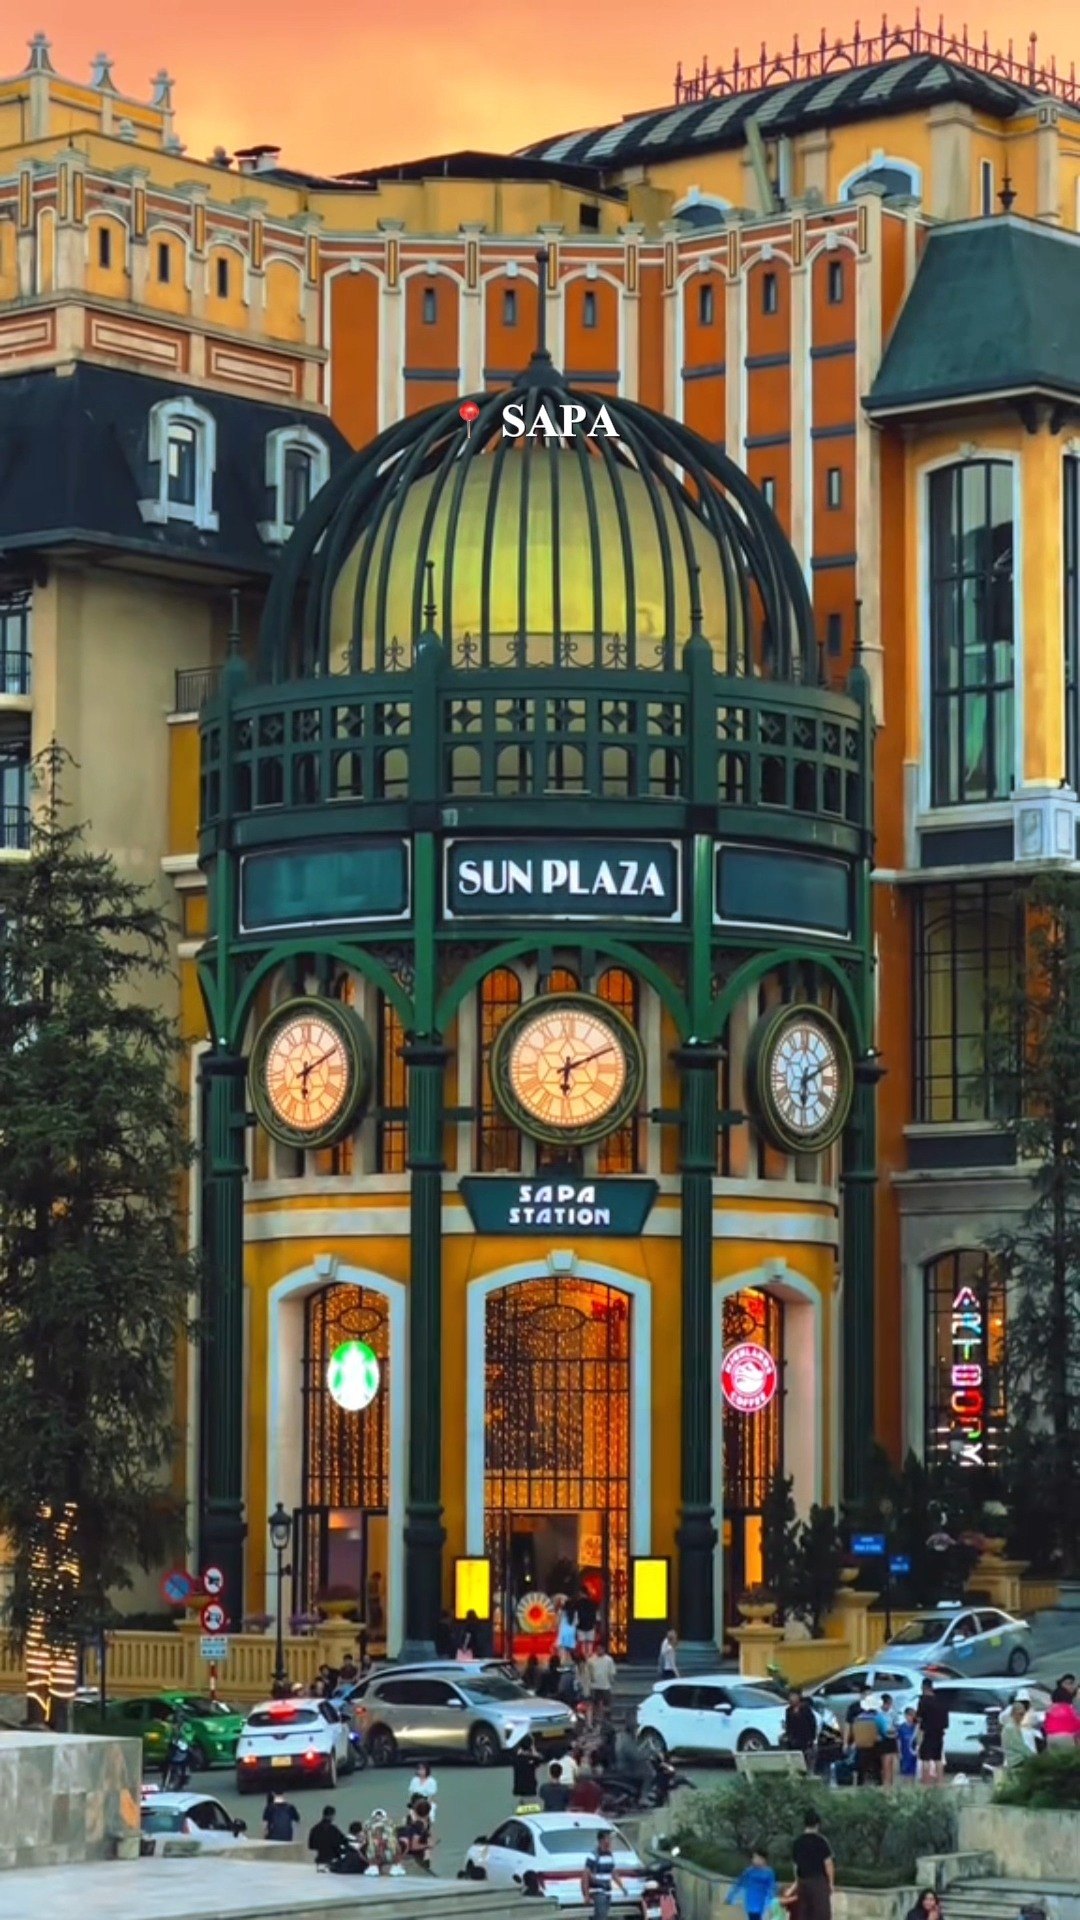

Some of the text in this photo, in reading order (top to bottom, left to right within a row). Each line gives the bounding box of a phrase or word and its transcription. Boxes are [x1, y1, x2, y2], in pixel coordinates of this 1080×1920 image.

[458, 859, 665, 896] SUN PLAZA
[518, 1184, 595, 1203] SAPA
[508, 1207, 610, 1225] STATION
